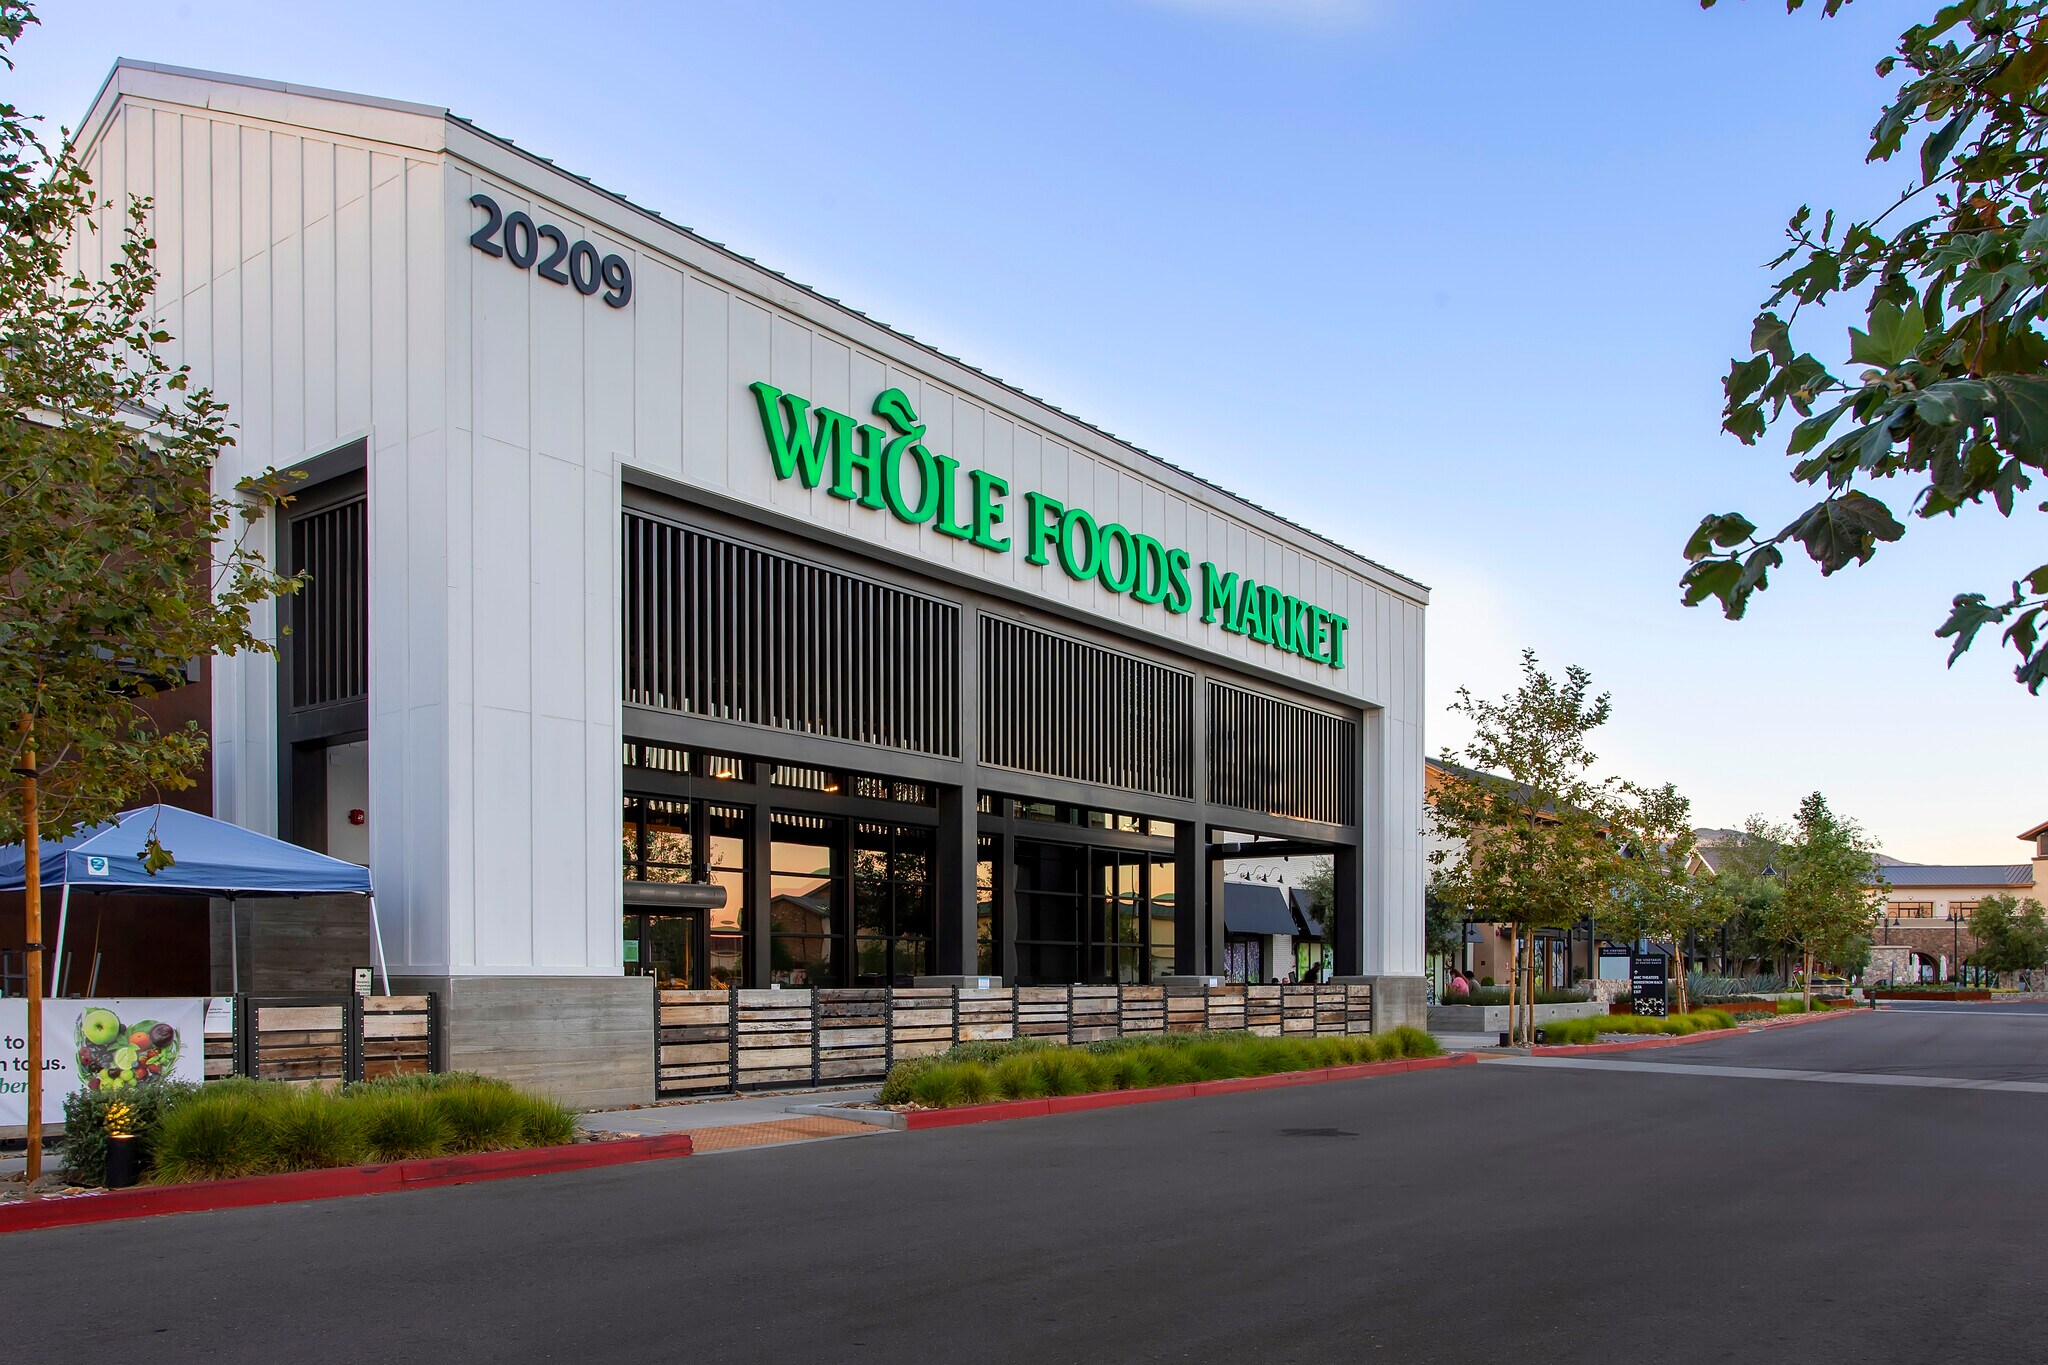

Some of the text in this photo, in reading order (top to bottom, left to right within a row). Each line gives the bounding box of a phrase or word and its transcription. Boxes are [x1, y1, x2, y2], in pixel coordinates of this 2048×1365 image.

[469, 194, 632, 308] 20209
[749, 381, 1349, 669] WHOLE FOODS MARKET
[4, 1035, 25, 1049] to
[41, 1059, 66, 1070] us.
